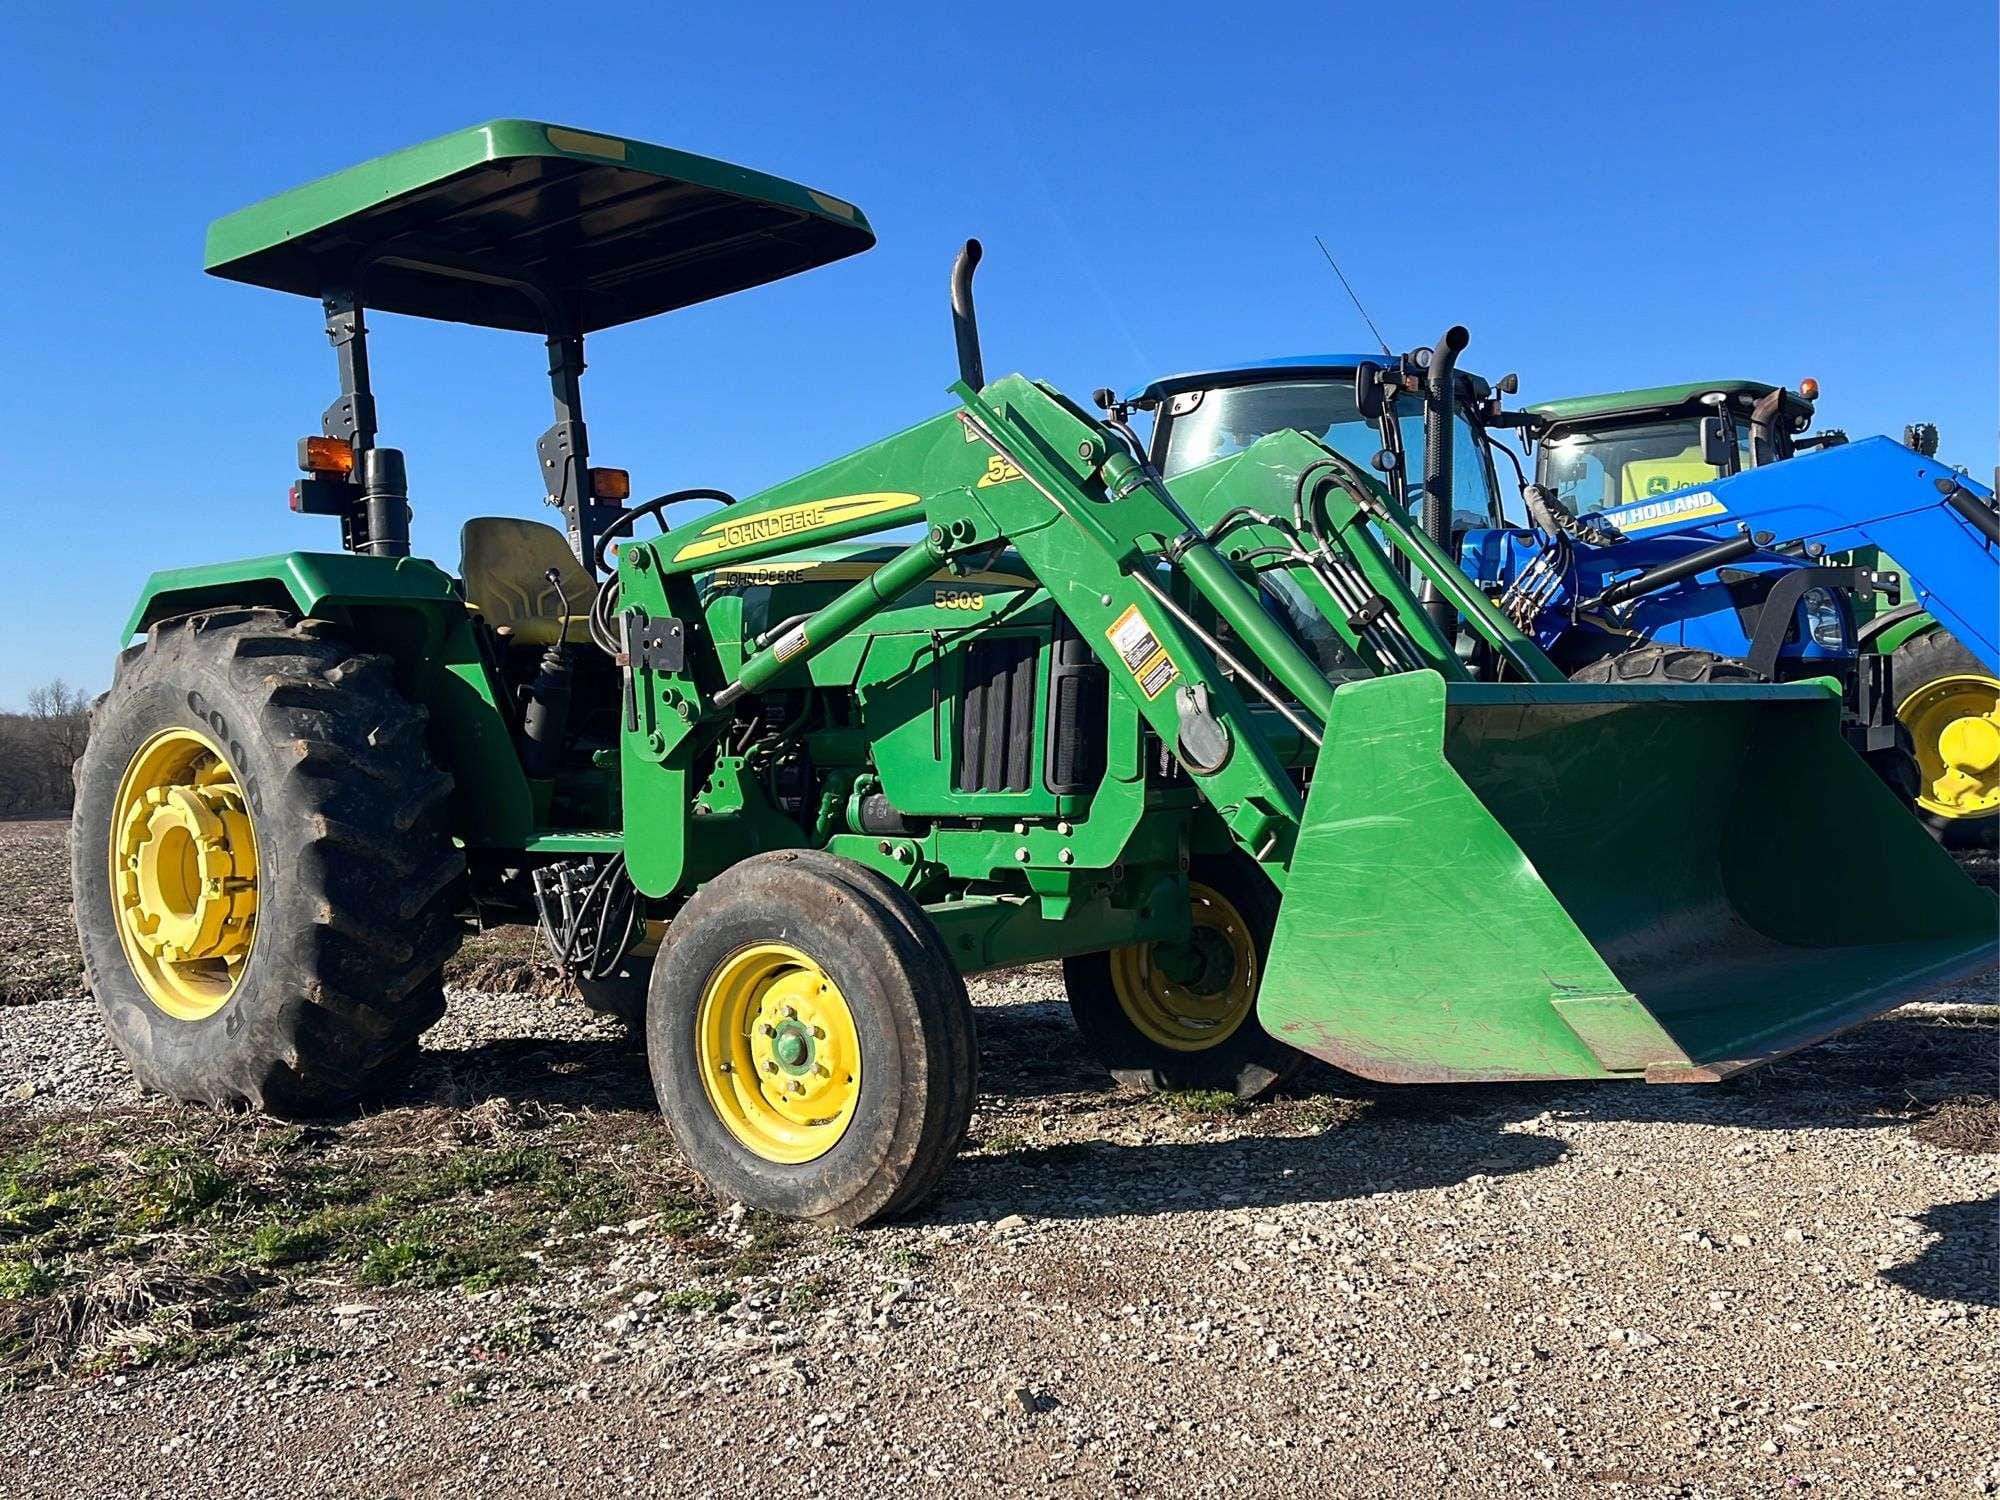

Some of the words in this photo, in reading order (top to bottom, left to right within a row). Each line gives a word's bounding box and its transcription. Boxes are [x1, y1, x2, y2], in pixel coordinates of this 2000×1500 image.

[1672, 480, 1709, 491] JOH
[1630, 491, 1714, 523] HOLLAND
[718, 517, 767, 549] JOHN
[766, 508, 826, 537] DEERE
[723, 571, 758, 587] JOHN
[758, 568, 805, 584] DEERE
[933, 590, 984, 611] 5303
